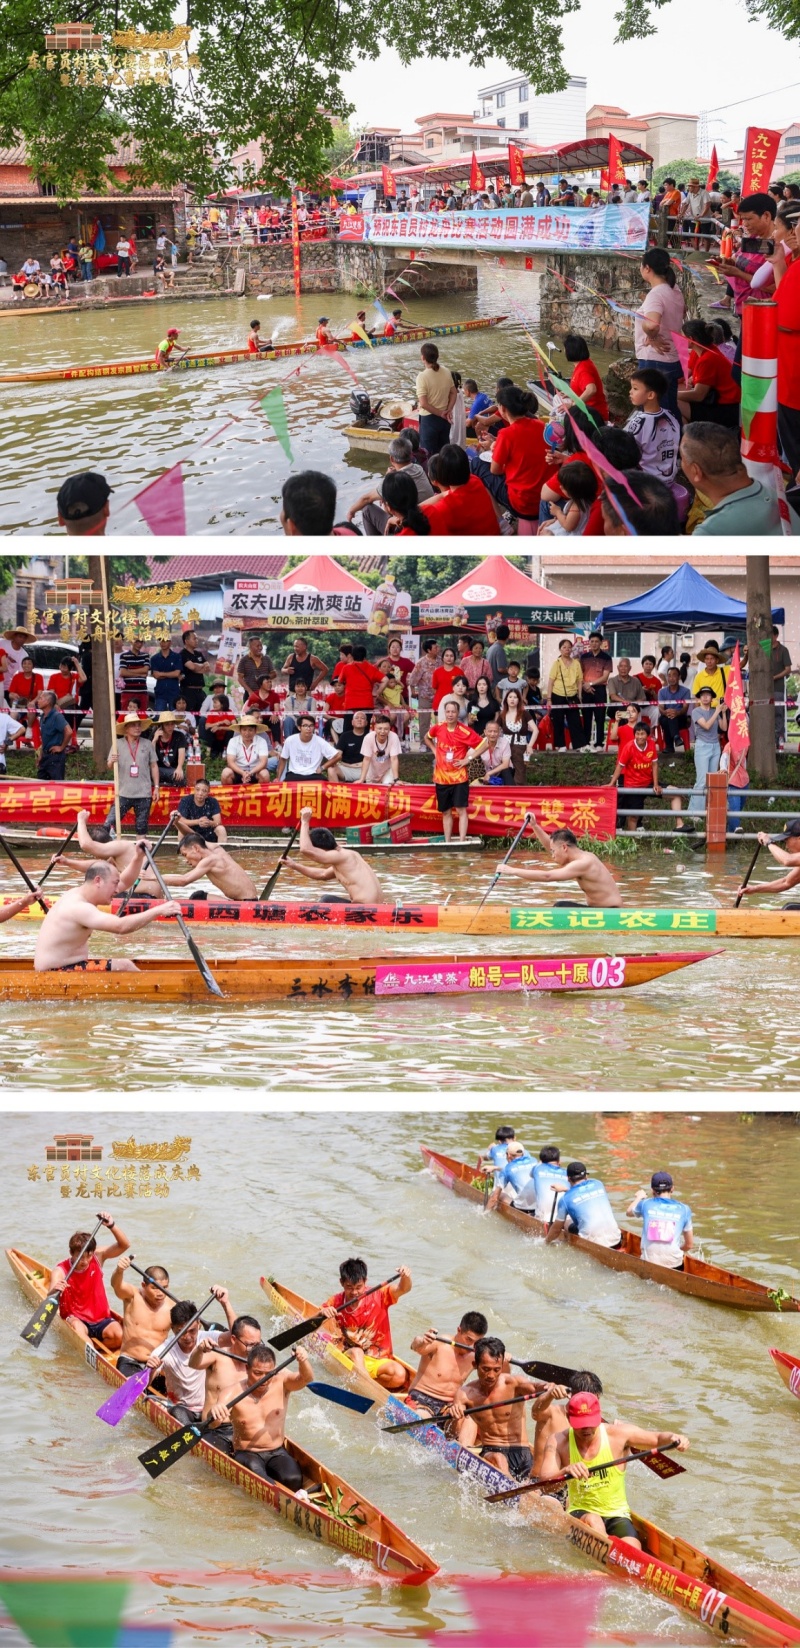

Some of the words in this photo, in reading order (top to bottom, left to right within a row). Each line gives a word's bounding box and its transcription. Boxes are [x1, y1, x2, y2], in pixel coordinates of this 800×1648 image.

[231, 593, 362, 613] 农夫山泉冰爽站
[271, 616, 329, 625] 100%茶叶萃取
[531, 609, 575, 622] 农夫山泉
[516, 909, 710, 930] 沃记农庄
[591, 957, 626, 988] 03
[700, 1588, 727, 1627] 07
